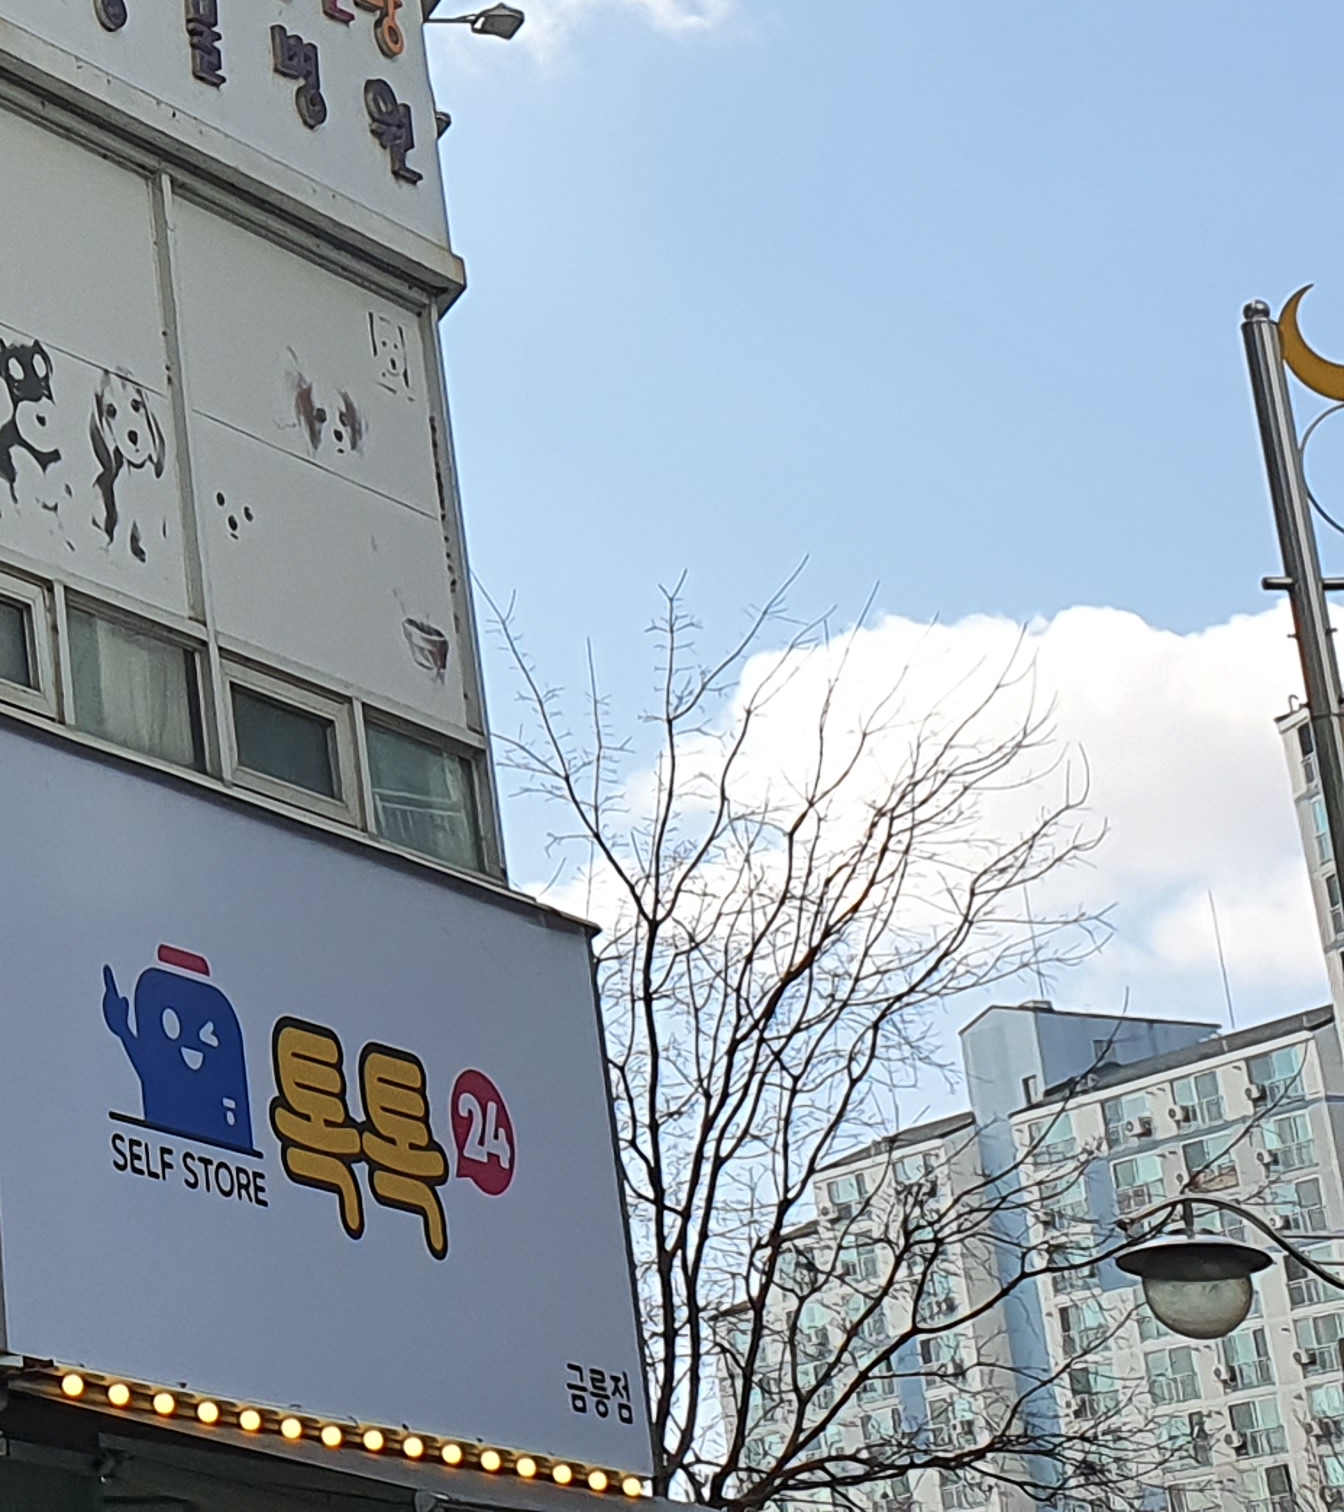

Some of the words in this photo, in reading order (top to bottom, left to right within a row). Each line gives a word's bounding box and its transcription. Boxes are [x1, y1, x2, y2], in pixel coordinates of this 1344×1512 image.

[111, 1131, 175, 1184] SELF
[181, 1151, 270, 1209] STORE
[268, 1014, 450, 1262] 톡톡
[456, 1090, 512, 1172] 24
[565, 1362, 634, 1426] 금릉점
